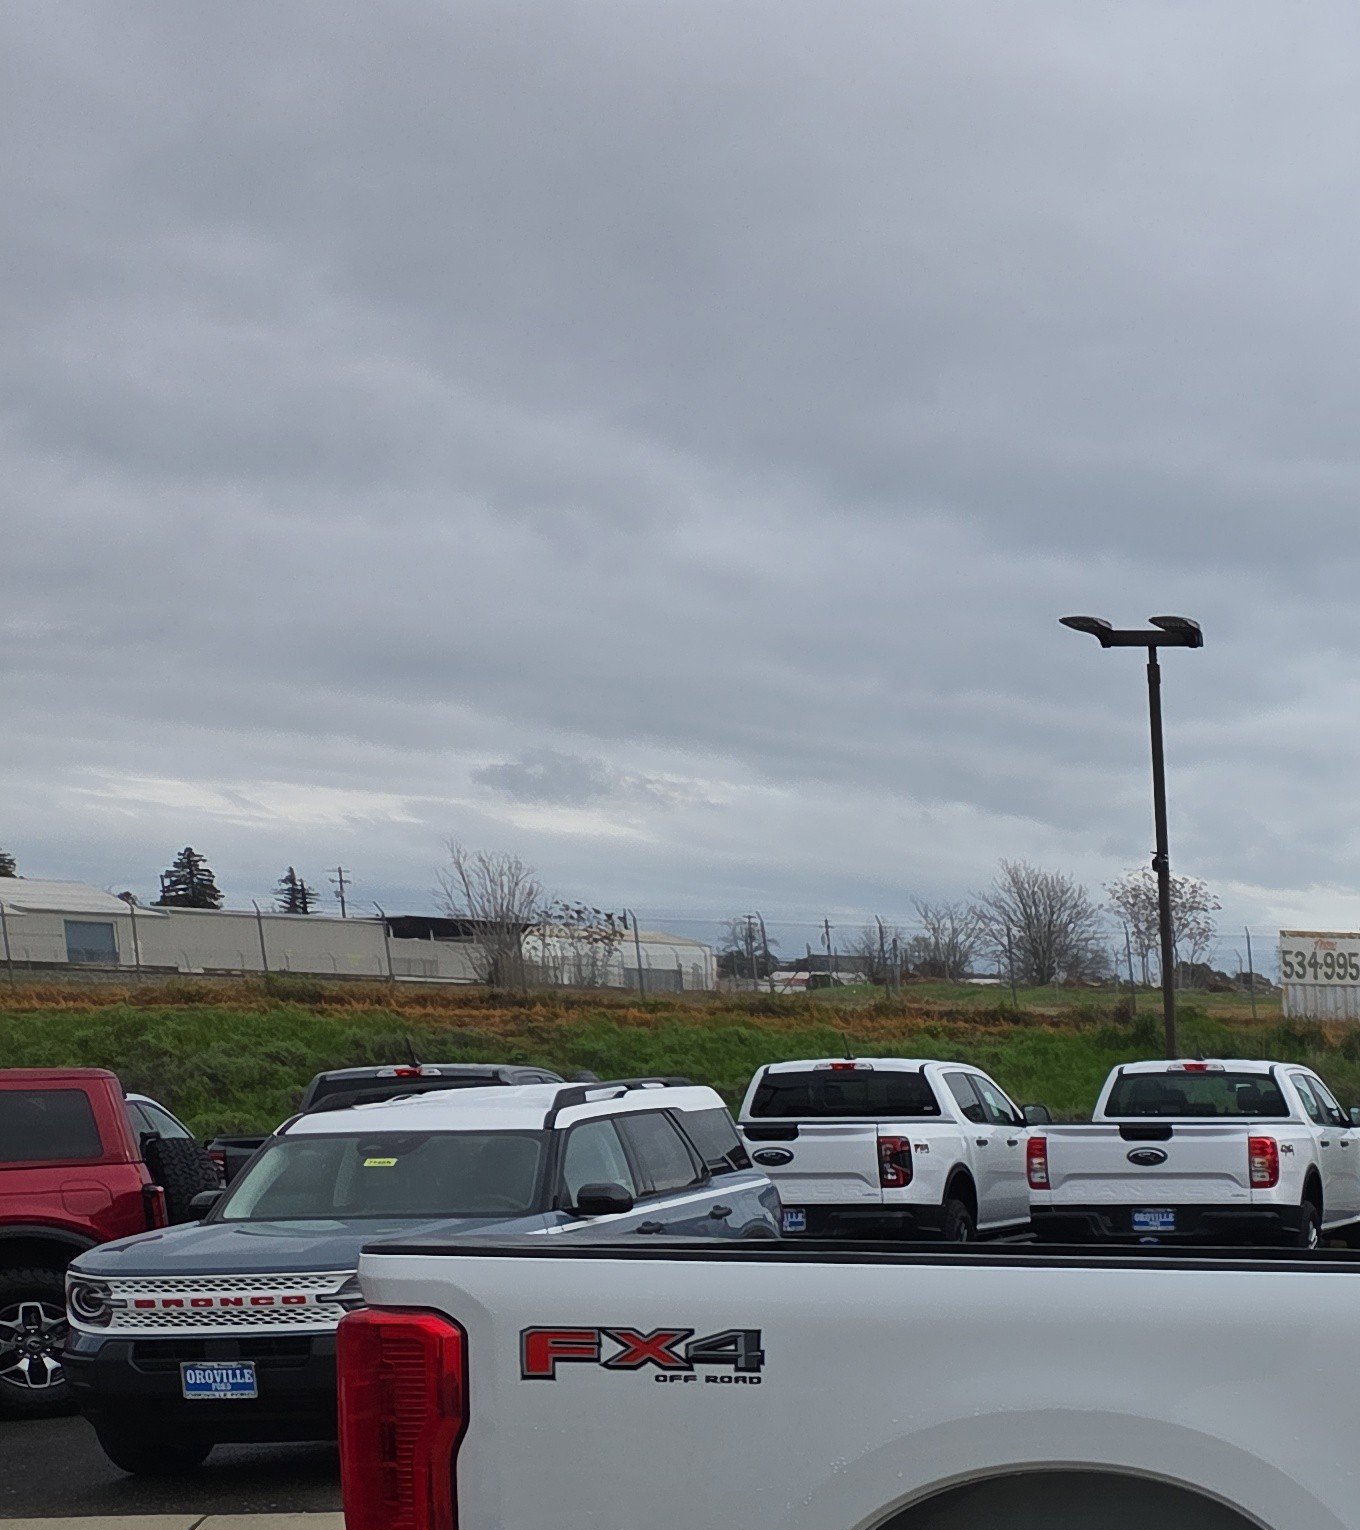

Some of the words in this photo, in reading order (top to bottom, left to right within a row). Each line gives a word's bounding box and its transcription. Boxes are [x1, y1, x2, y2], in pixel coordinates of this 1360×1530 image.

[134, 1295, 306, 1309] BRONCO
[519, 1325, 765, 1381] FX4
[186, 1368, 254, 1384] OROVILLE
[654, 1374, 698, 1383] OFF
[704, 1374, 763, 1385] ROAD
